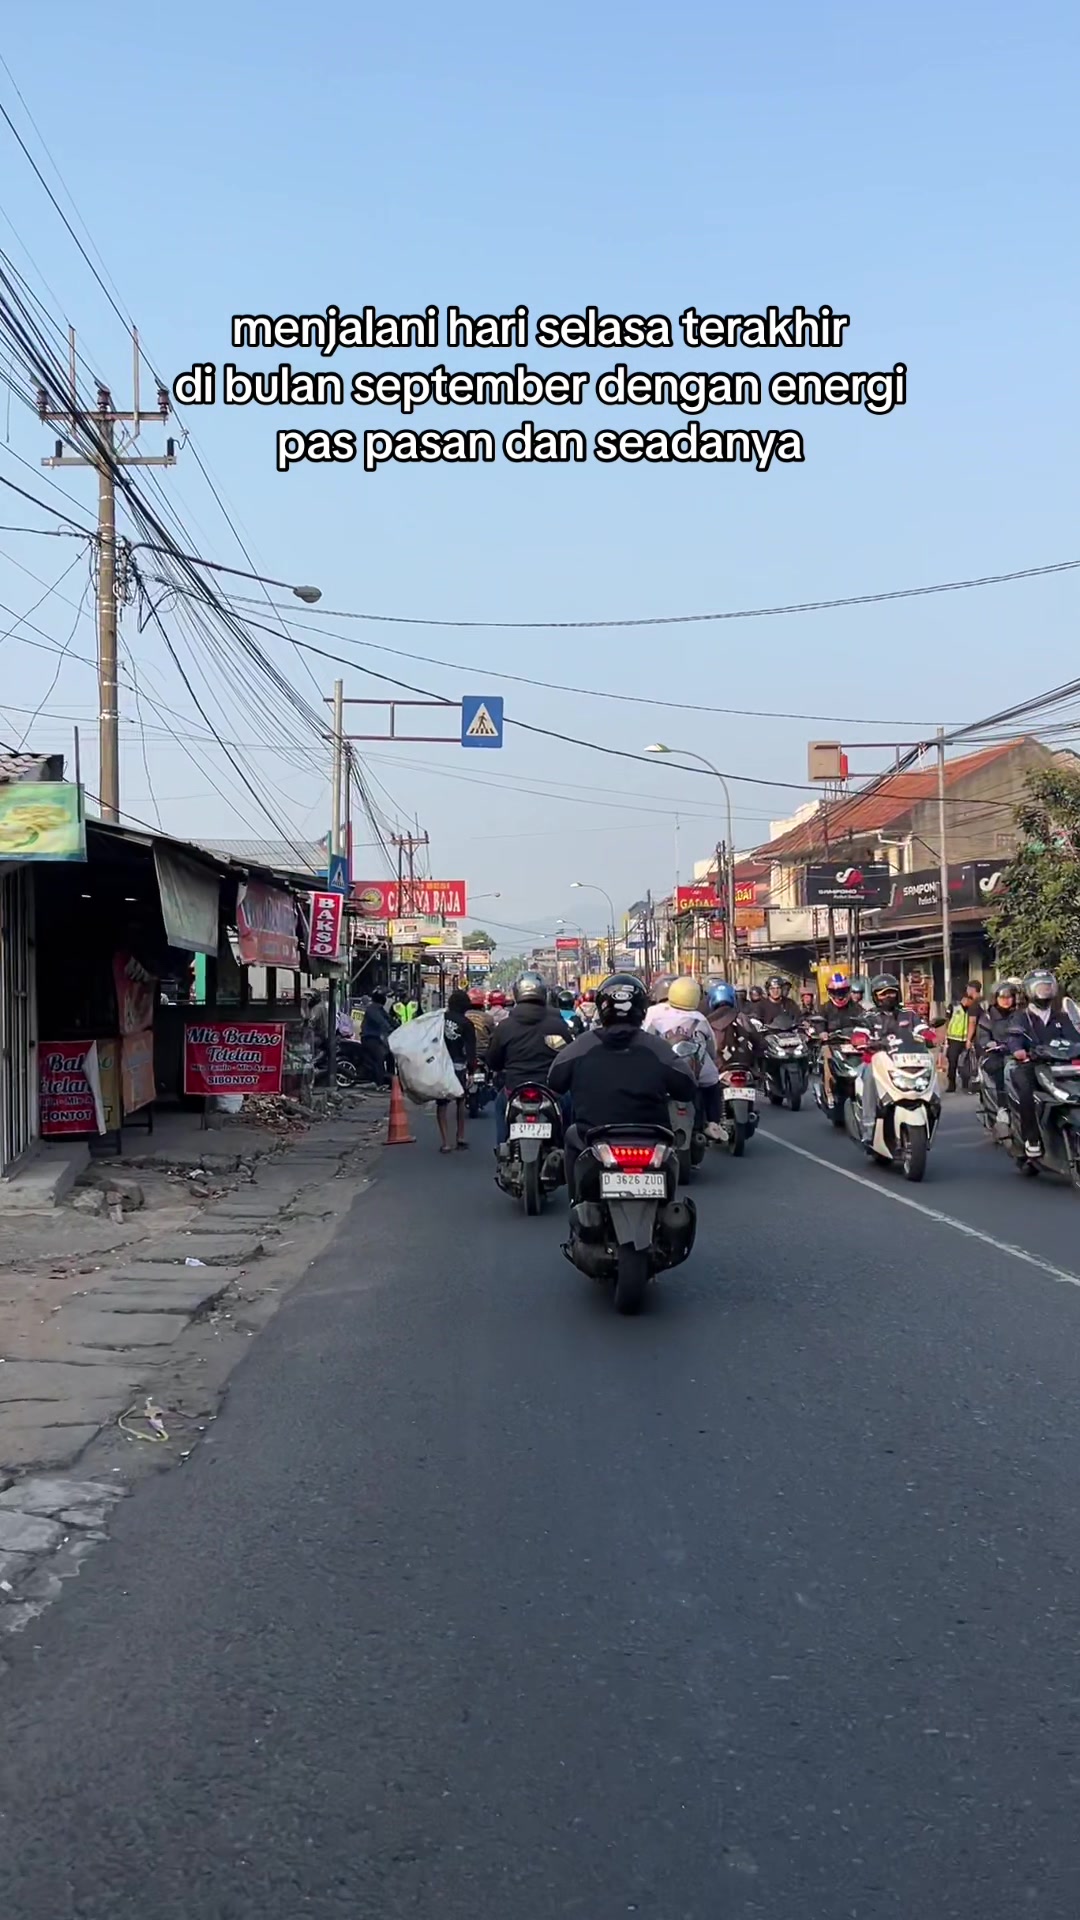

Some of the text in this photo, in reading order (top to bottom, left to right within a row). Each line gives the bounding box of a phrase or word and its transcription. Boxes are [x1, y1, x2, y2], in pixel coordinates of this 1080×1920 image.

[433, 890, 461, 912] BAJA
[314, 897, 336, 954] BAKSO
[187, 1027, 281, 1046] Mie Bakso
[207, 1075, 260, 1086] SIBONTOT
[604, 1174, 611, 1185] D
[616, 1175, 641, 1185] 3626
